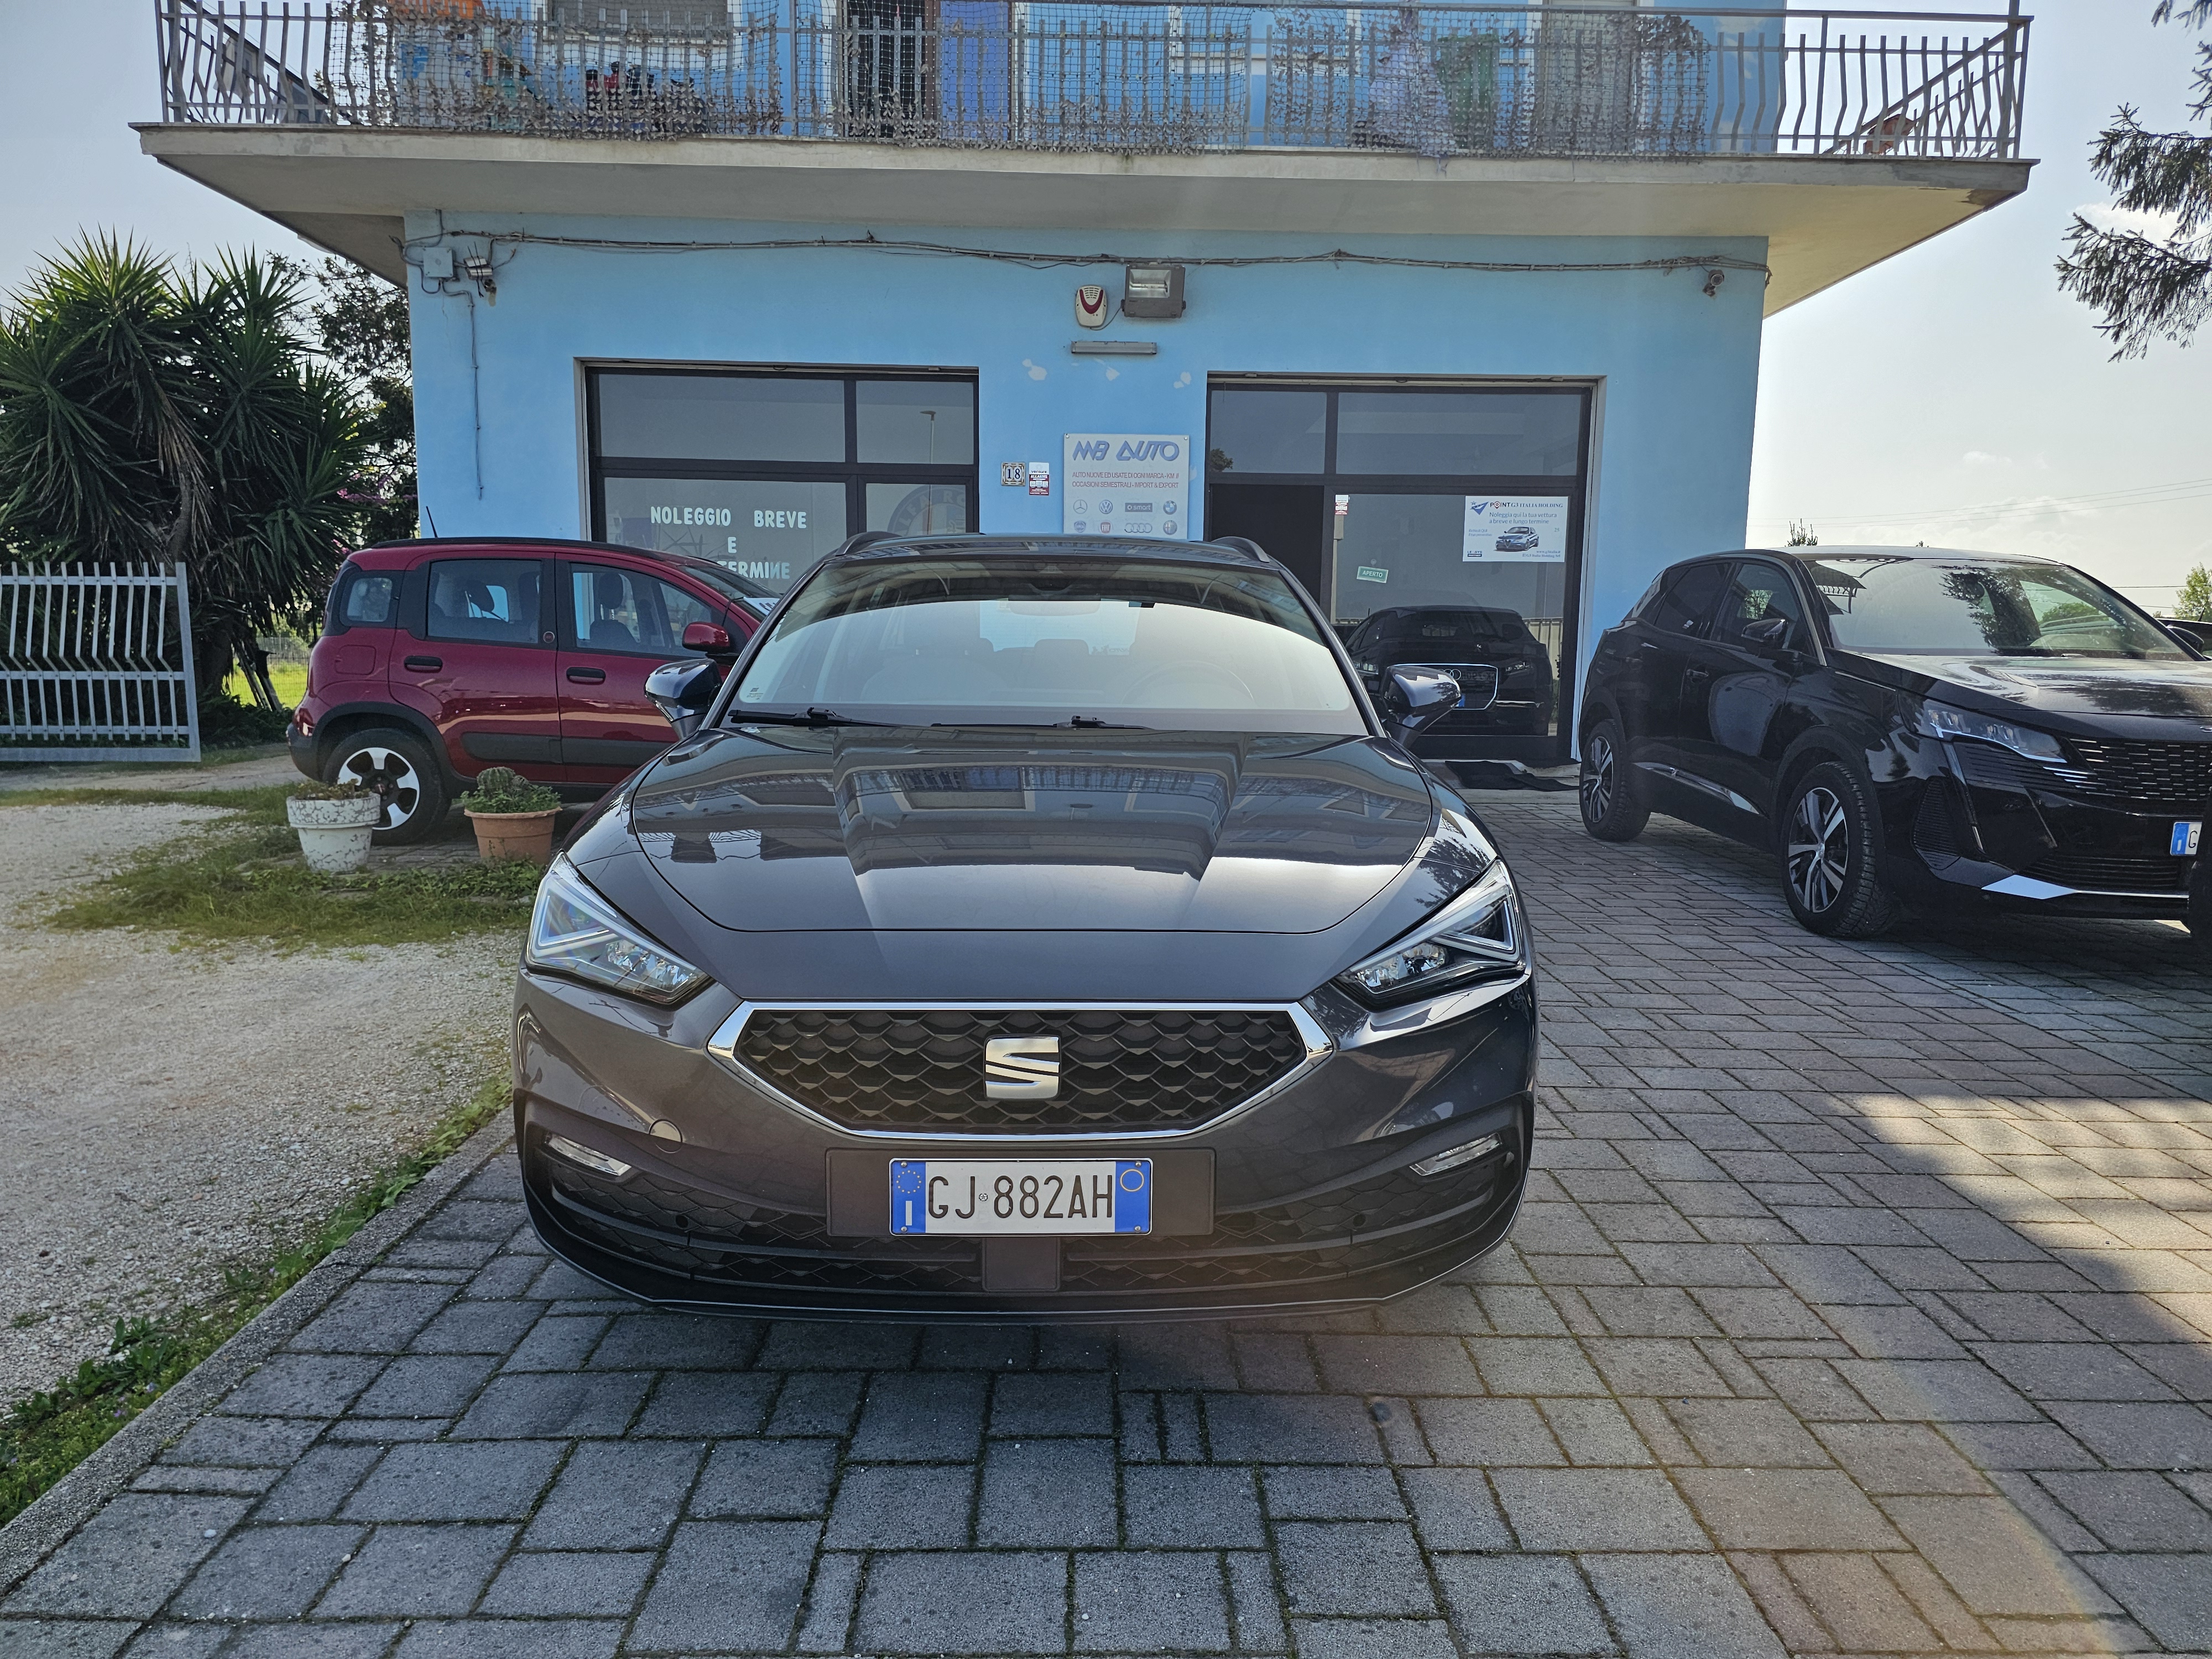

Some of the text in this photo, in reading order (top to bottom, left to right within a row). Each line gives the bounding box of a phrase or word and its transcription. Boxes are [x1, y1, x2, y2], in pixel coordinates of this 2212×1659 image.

[1072, 440, 1180, 461] MB AUTO
[1008, 468, 1020, 479] 18
[650, 506, 807, 529] NOLEGGIO BREVE
[727, 536, 737, 553] E
